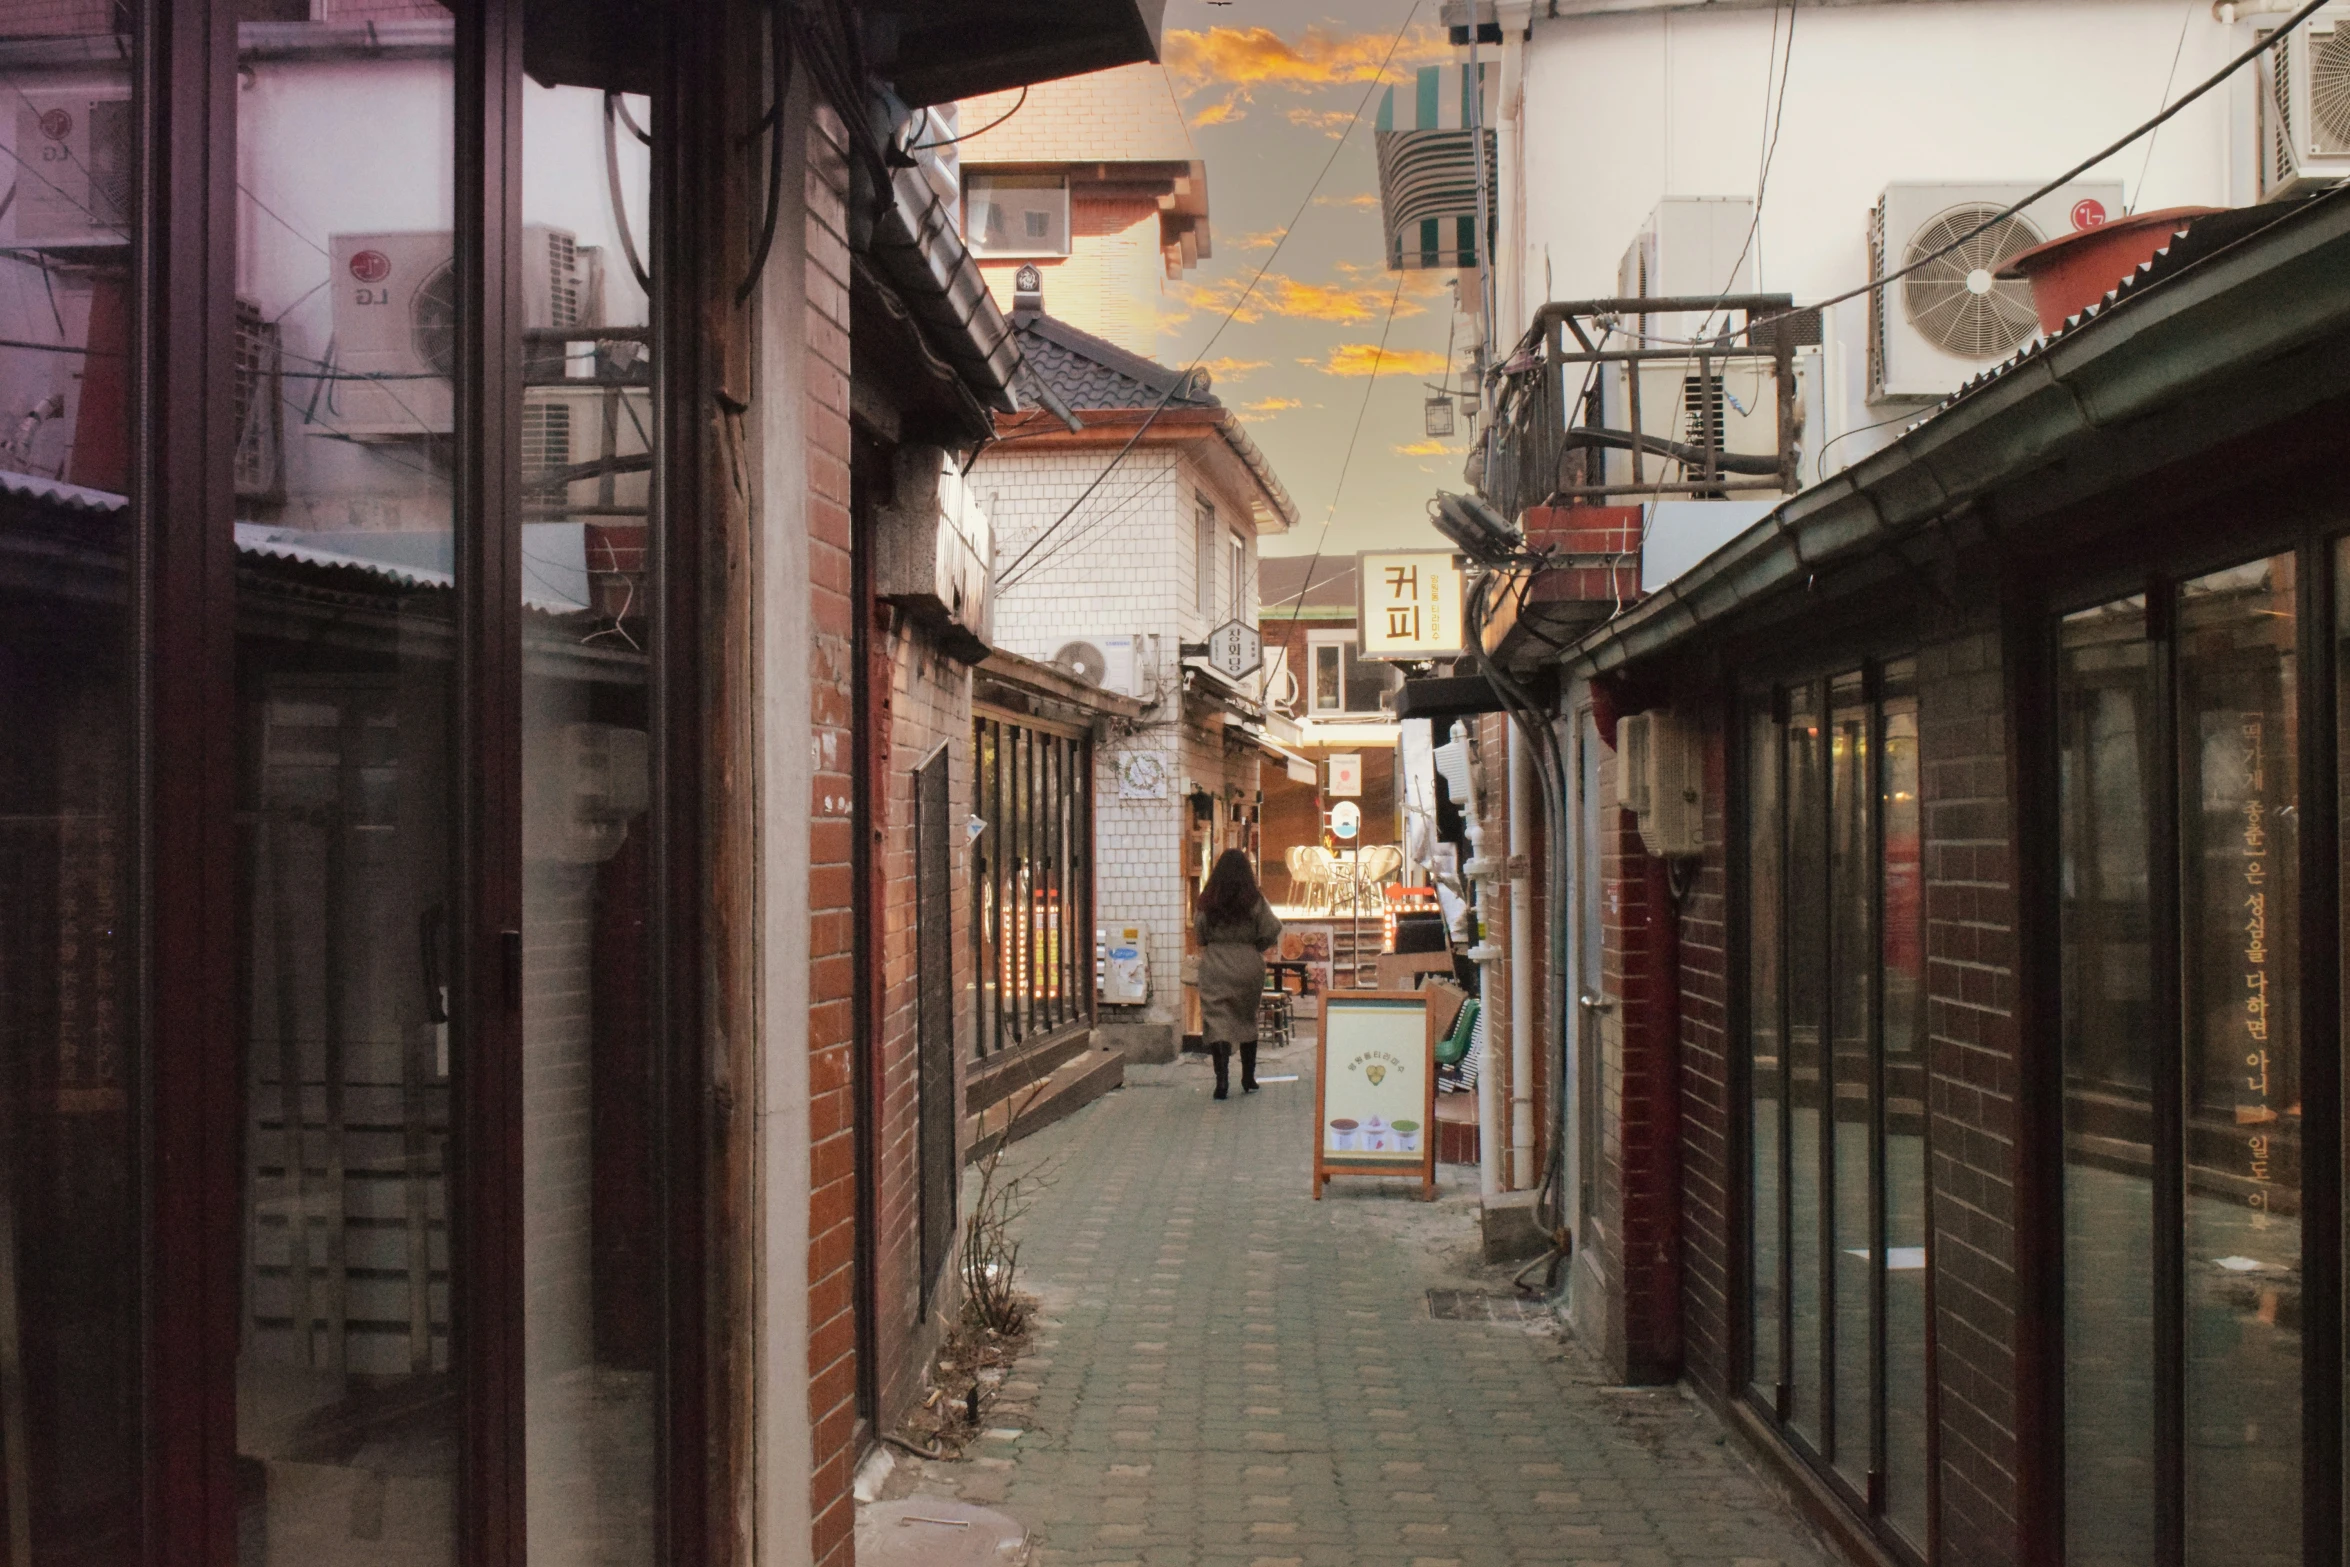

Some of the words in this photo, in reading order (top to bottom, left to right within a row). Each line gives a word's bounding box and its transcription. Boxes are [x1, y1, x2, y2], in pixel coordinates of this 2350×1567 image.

[1385, 565, 1420, 641] 커피
[2246, 970, 2269, 1040] 다하면
[2246, 1050, 2271, 1096] 아니
